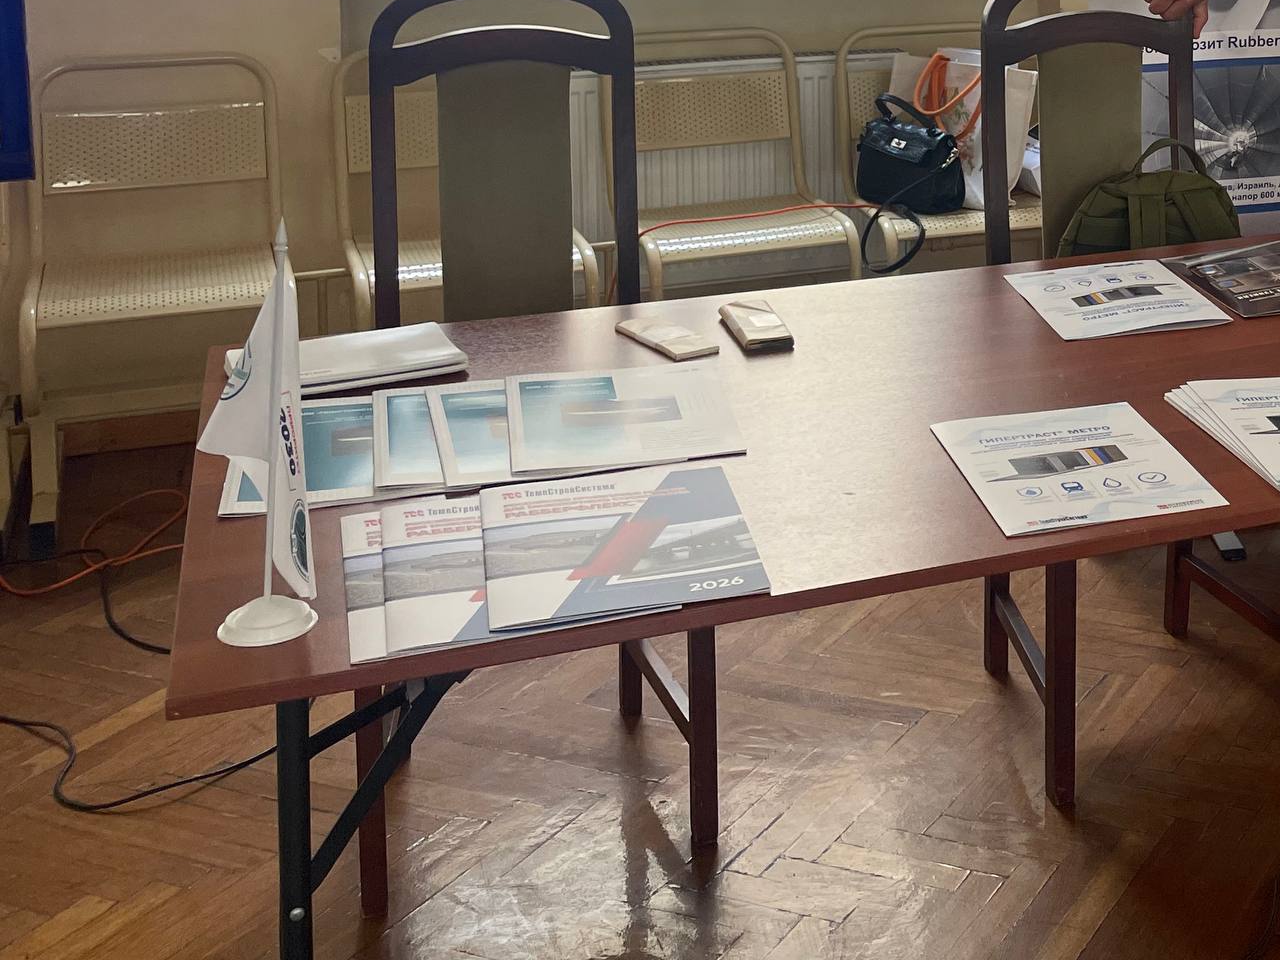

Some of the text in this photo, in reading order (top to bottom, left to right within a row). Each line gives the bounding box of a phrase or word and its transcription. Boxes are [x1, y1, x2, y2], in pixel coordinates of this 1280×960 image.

[1237, 181, 1277, 191] Израиль,
[1231, 192, 1258, 201] напор
[1260, 191, 1275, 199] 600
[1067, 425, 1111, 435] МЕТРО
[428, 505, 480, 516] ТемпСтрой
[688, 576, 744, 592] 2026
